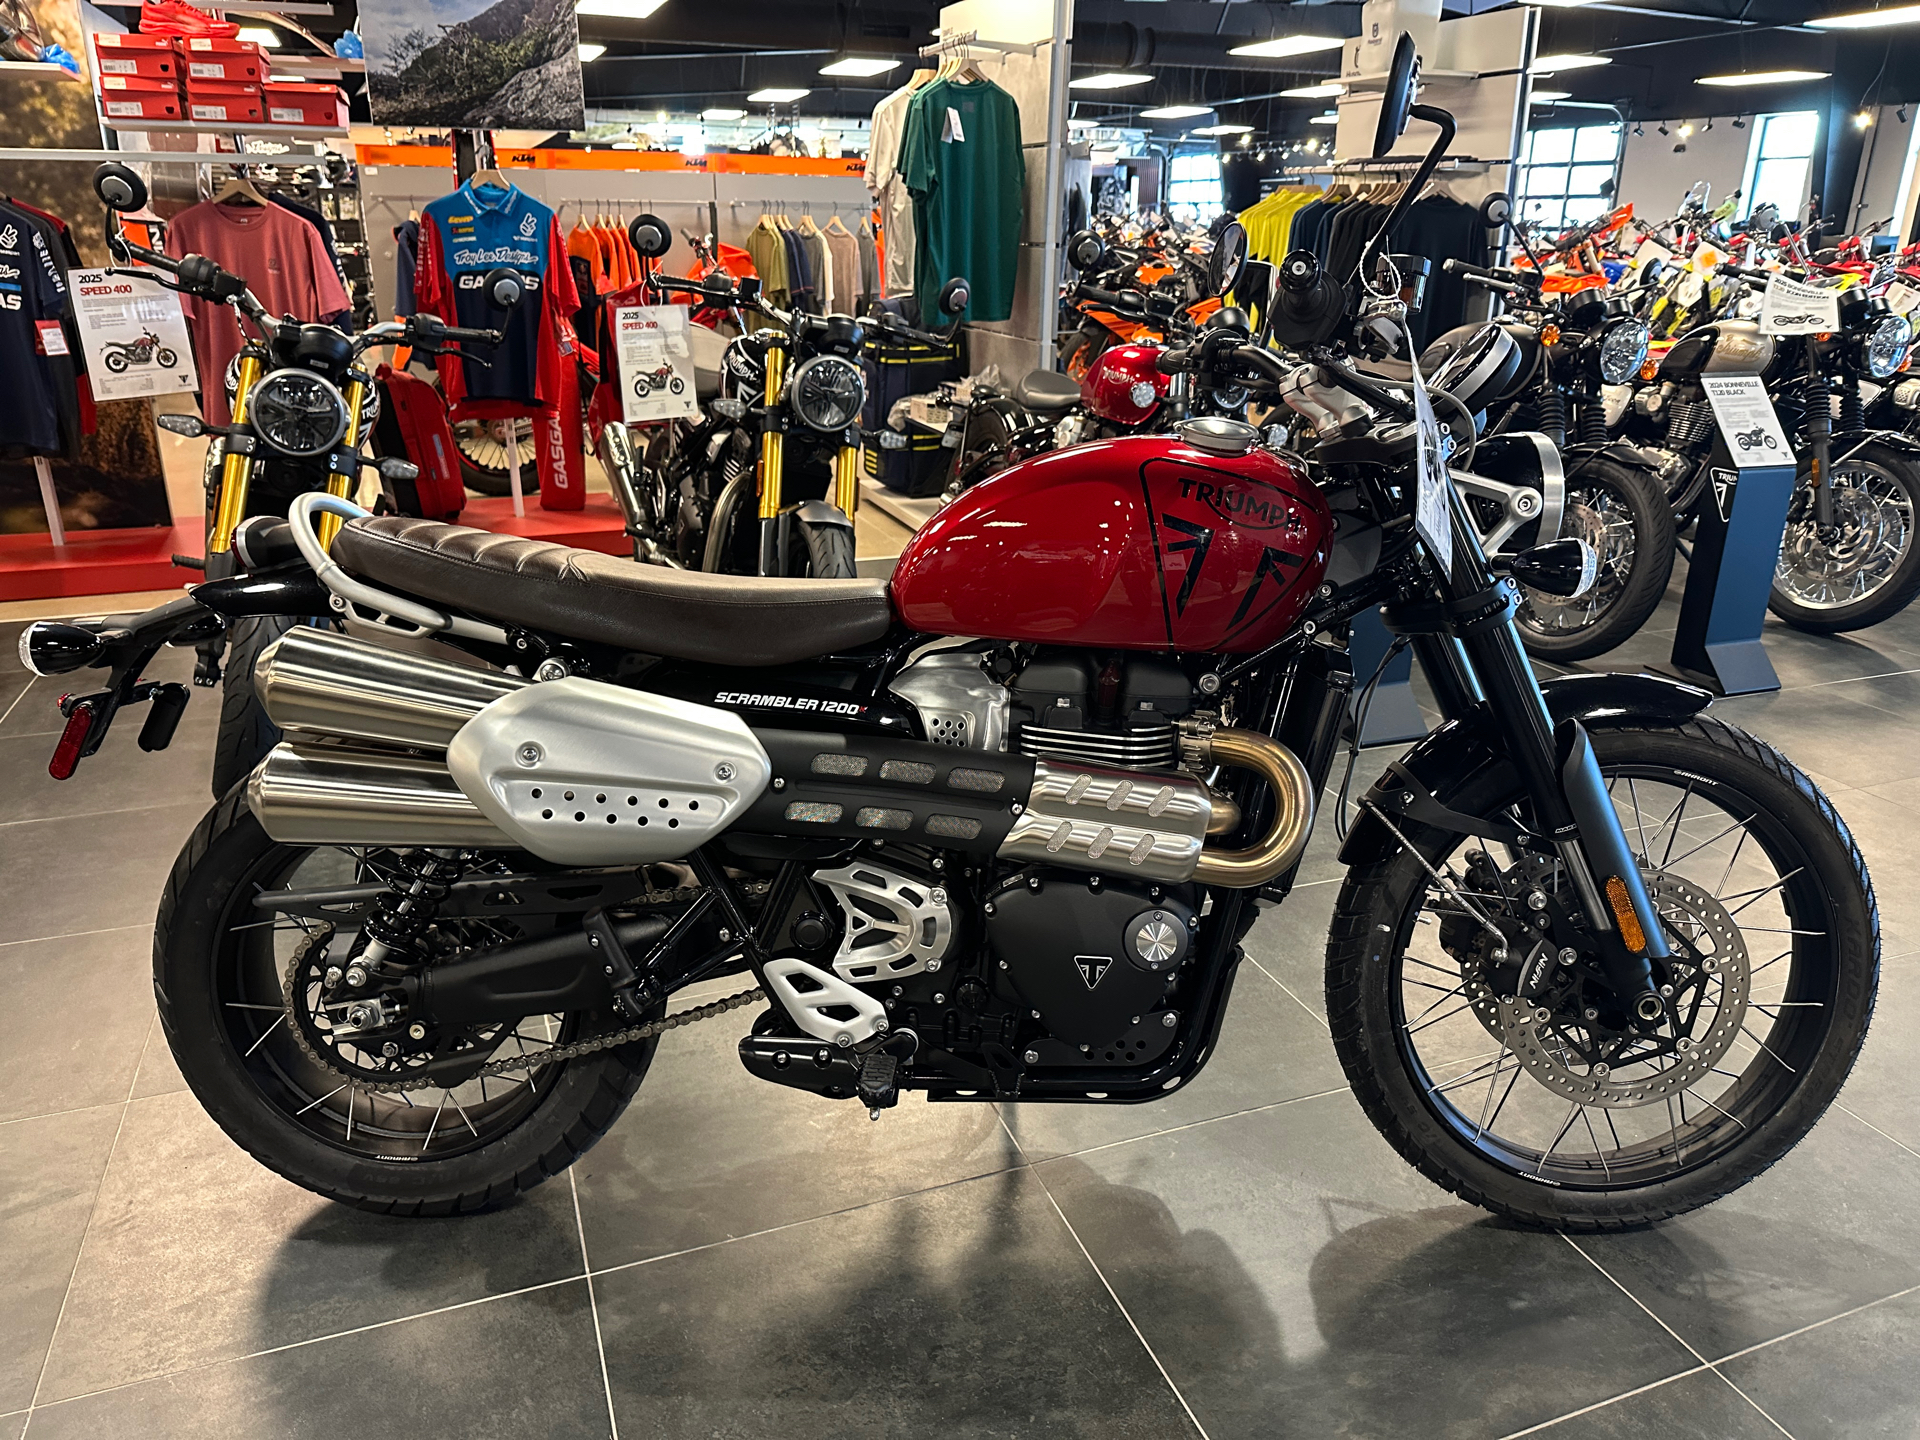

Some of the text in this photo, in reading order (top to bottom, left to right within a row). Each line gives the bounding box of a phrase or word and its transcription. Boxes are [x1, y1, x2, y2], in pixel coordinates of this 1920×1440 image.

[512, 154, 536, 164] KTM
[454, 246, 538, 266] Troy Lee Designs
[78, 274, 103, 284] 2025
[80, 284, 133, 296] SPEED 400
[622, 312, 639, 320] 2025
[622, 321, 658, 331] SPEED 400
[1708, 380, 1760, 389] 2024 BONNEVILLE
[1725, 388, 1746, 396] BLACK
[1178, 477, 1302, 537] TRIUMPH
[714, 691, 819, 711] SCRAMBLER
